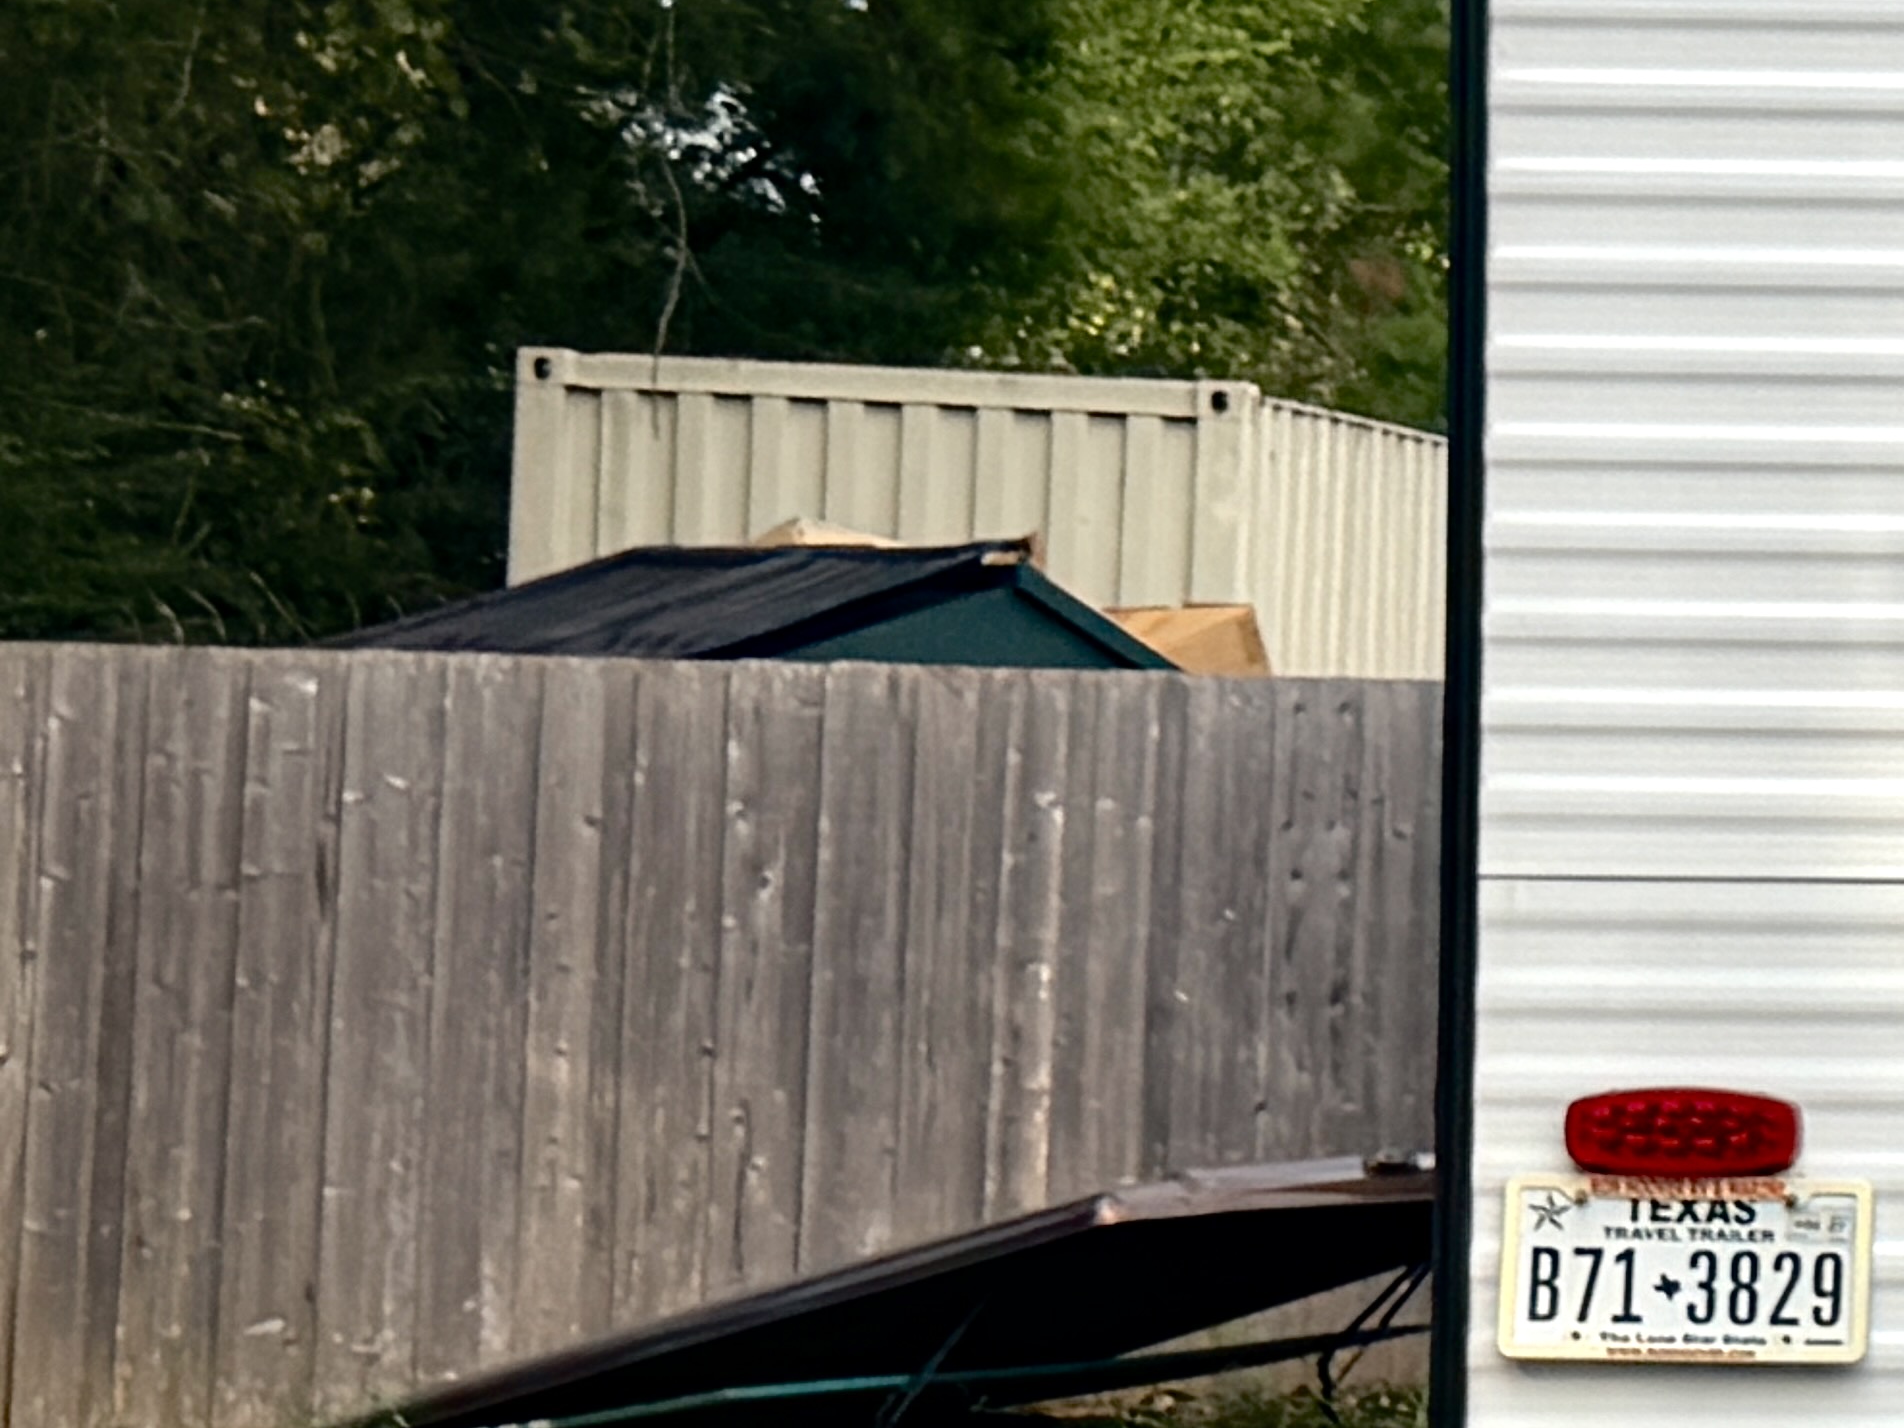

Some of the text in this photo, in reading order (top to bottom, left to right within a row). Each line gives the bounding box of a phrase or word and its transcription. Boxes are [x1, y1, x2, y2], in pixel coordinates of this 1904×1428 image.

[1627, 1197, 1757, 1225] TEXAS
[1603, 1225, 1680, 1242] TRAVEL
[1688, 1226, 1776, 1244] TRAILER
[1527, 1245, 1843, 1328] B71 3829
